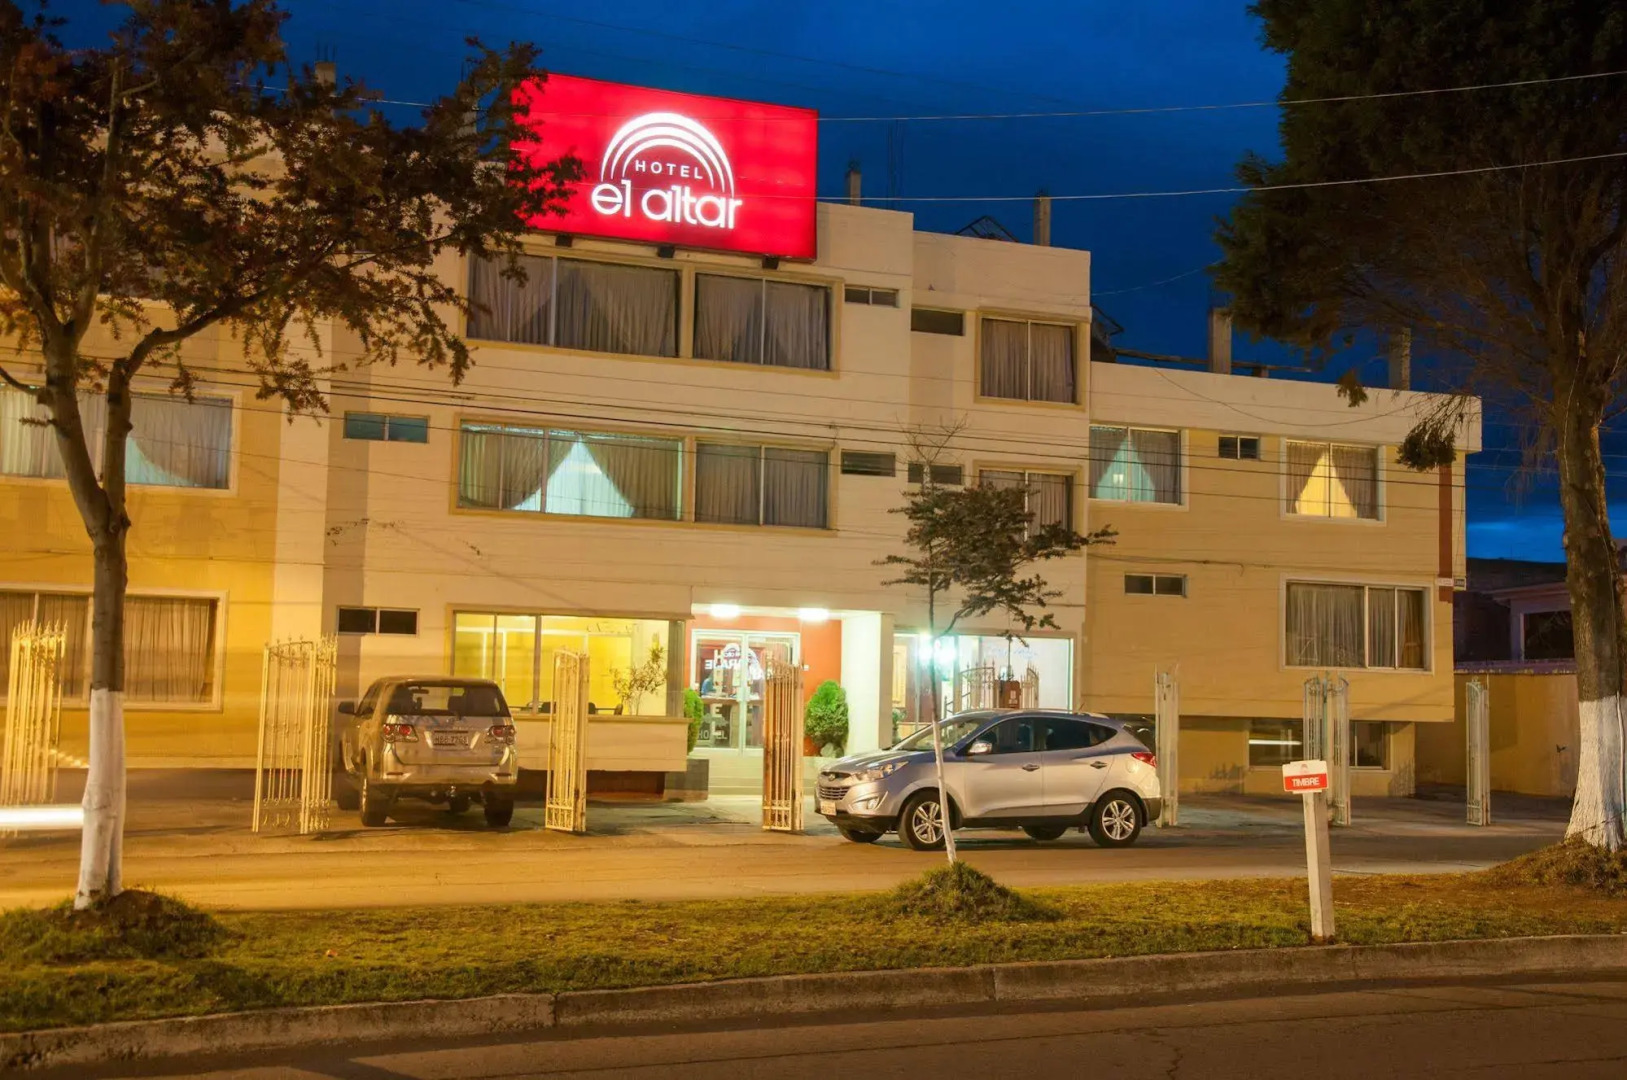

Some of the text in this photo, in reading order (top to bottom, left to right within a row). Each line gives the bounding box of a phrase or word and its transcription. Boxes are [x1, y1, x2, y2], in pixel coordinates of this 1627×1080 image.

[635, 160, 703, 179] HOTEL
[591, 179, 743, 229] el altar
[1291, 777, 1320, 788] TIMBRE
